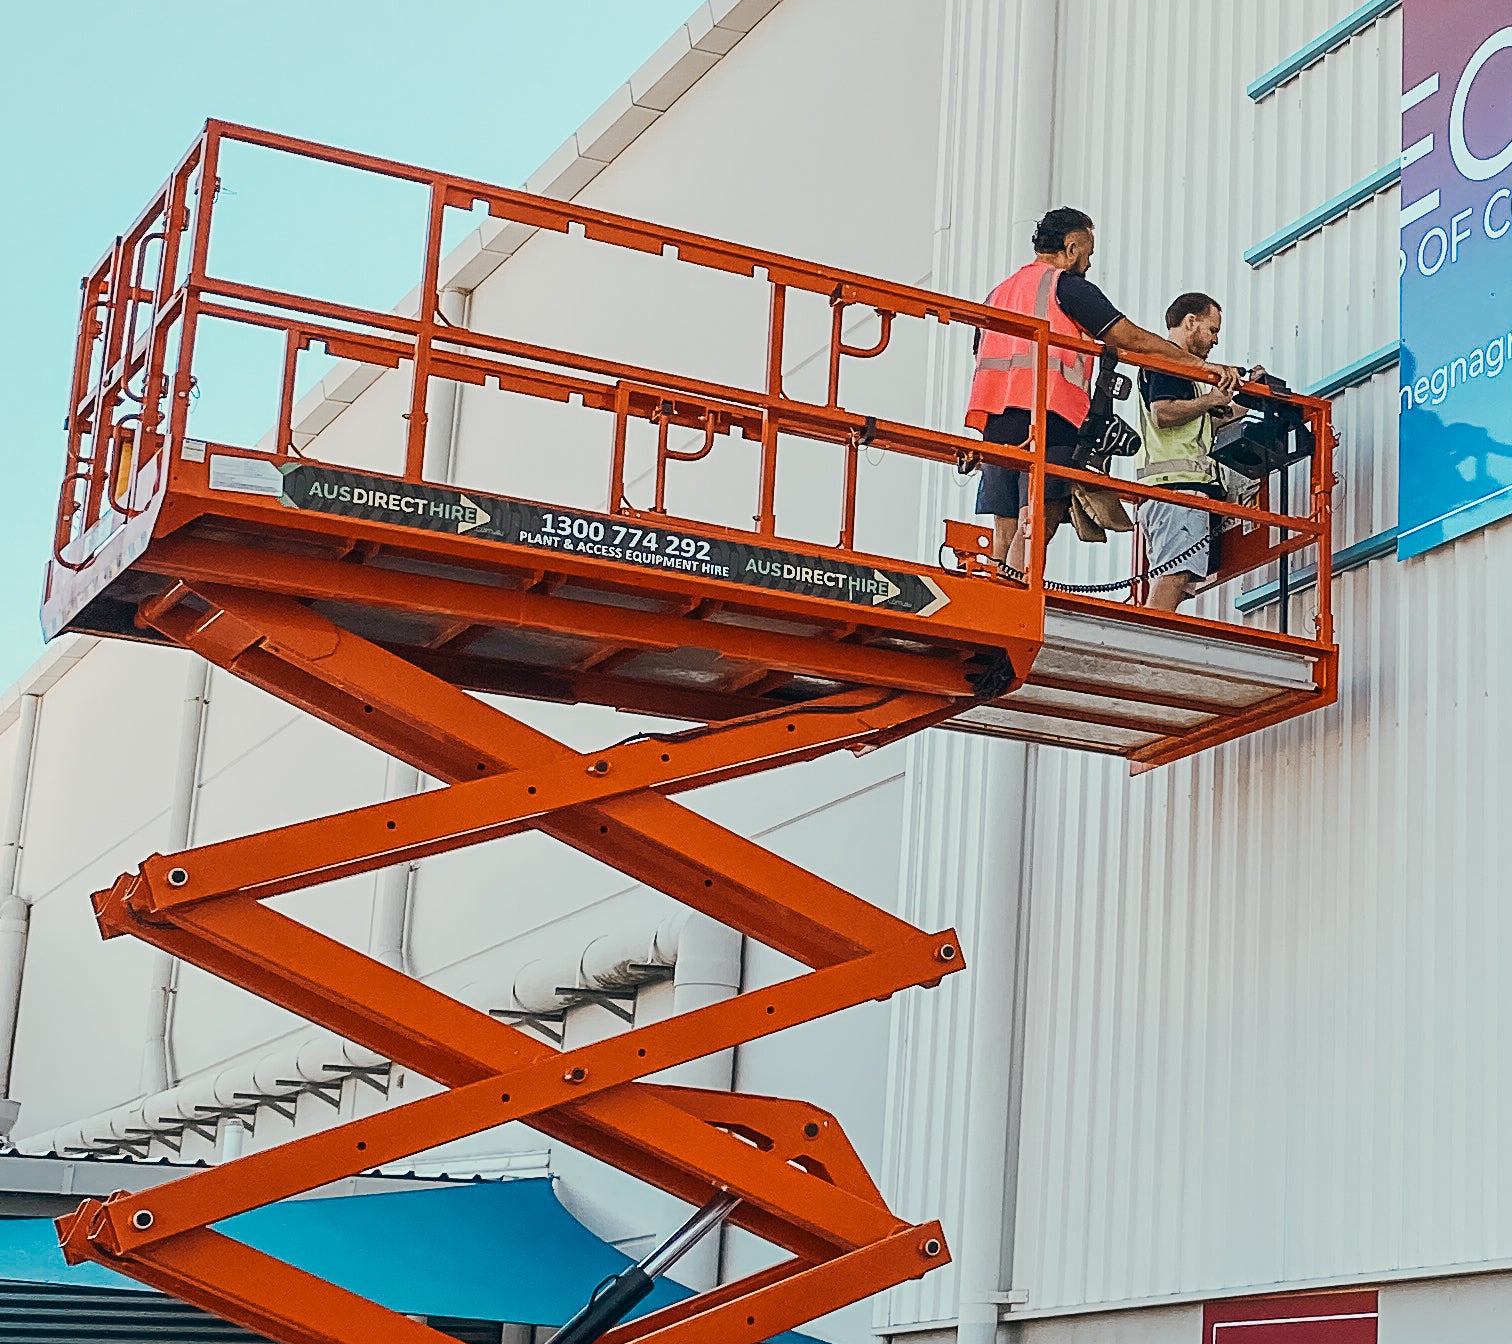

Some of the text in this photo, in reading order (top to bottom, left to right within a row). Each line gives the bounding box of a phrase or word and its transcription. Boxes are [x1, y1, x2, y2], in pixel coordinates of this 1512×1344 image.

[1418, 208, 1472, 276] OF
[519, 530, 730, 577] PLANT & ACCESS EQUIPMENT HIRE
[542, 513, 711, 560] 1300 774 292
